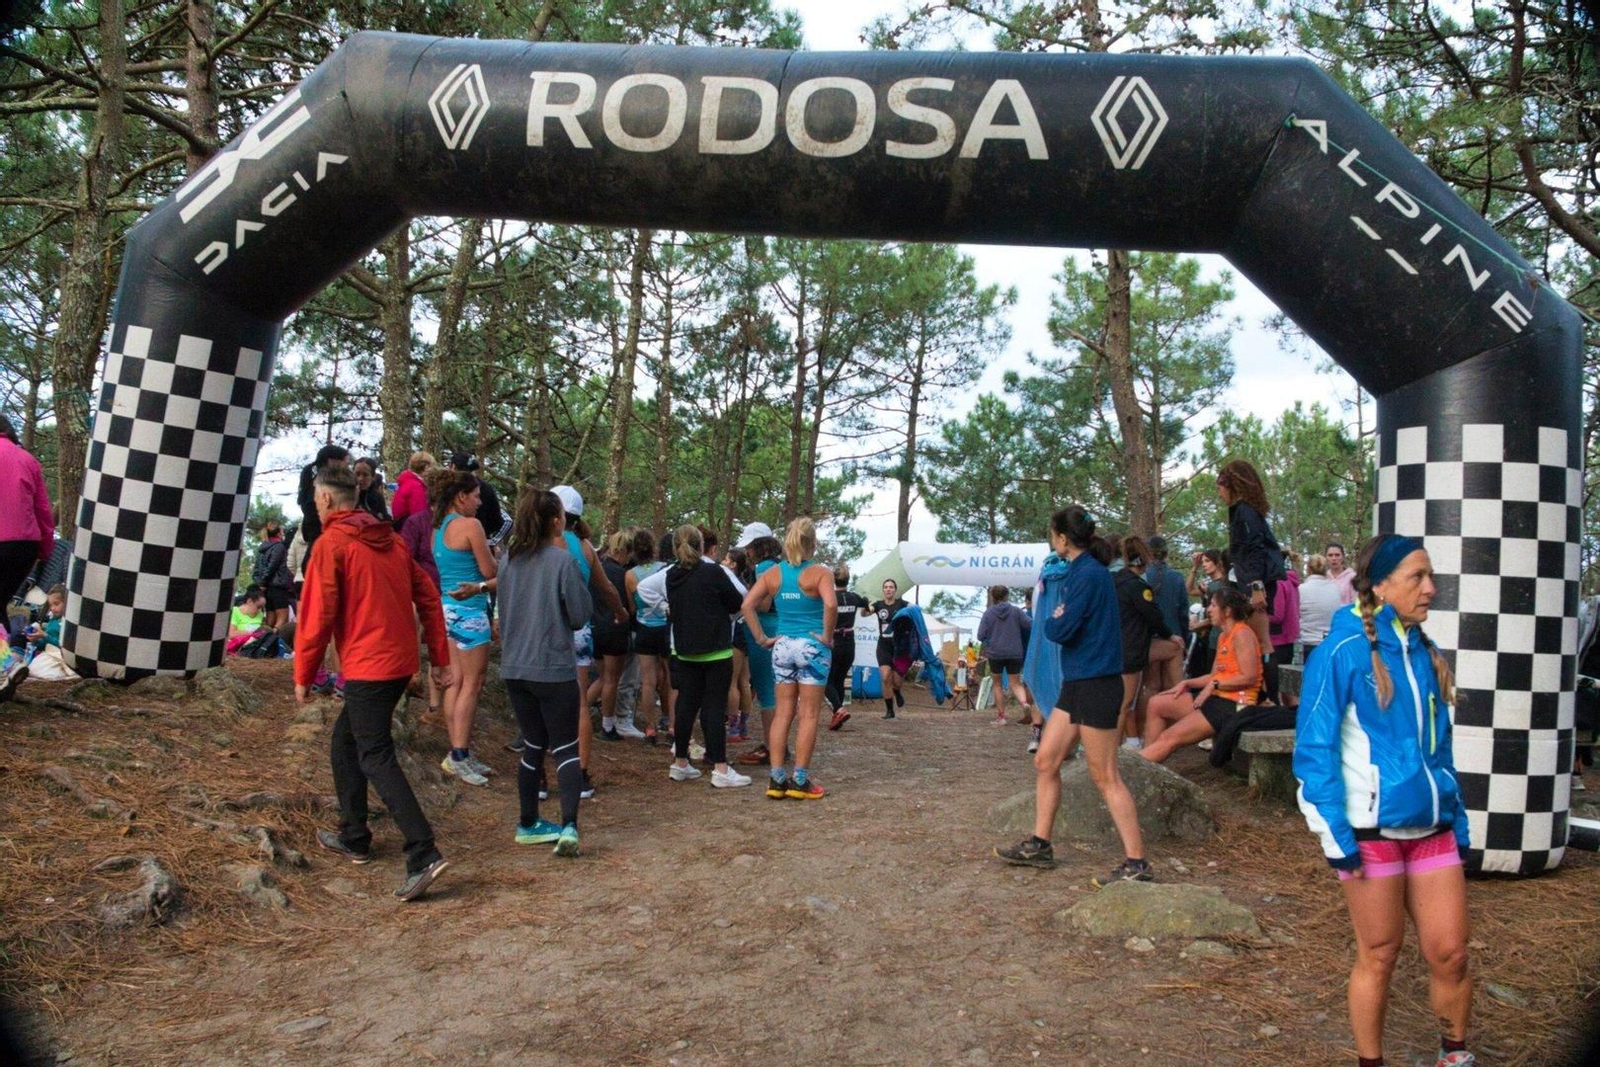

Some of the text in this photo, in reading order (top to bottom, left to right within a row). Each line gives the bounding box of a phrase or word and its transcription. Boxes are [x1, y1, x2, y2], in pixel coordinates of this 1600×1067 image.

[525, 70, 1050, 161] RODOSA
[193, 151, 350, 276] DACIA
[1293, 118, 1534, 333] ALPINE
[781, 592, 801, 600] TRINI
[969, 553, 1034, 568] NIGRÁN
